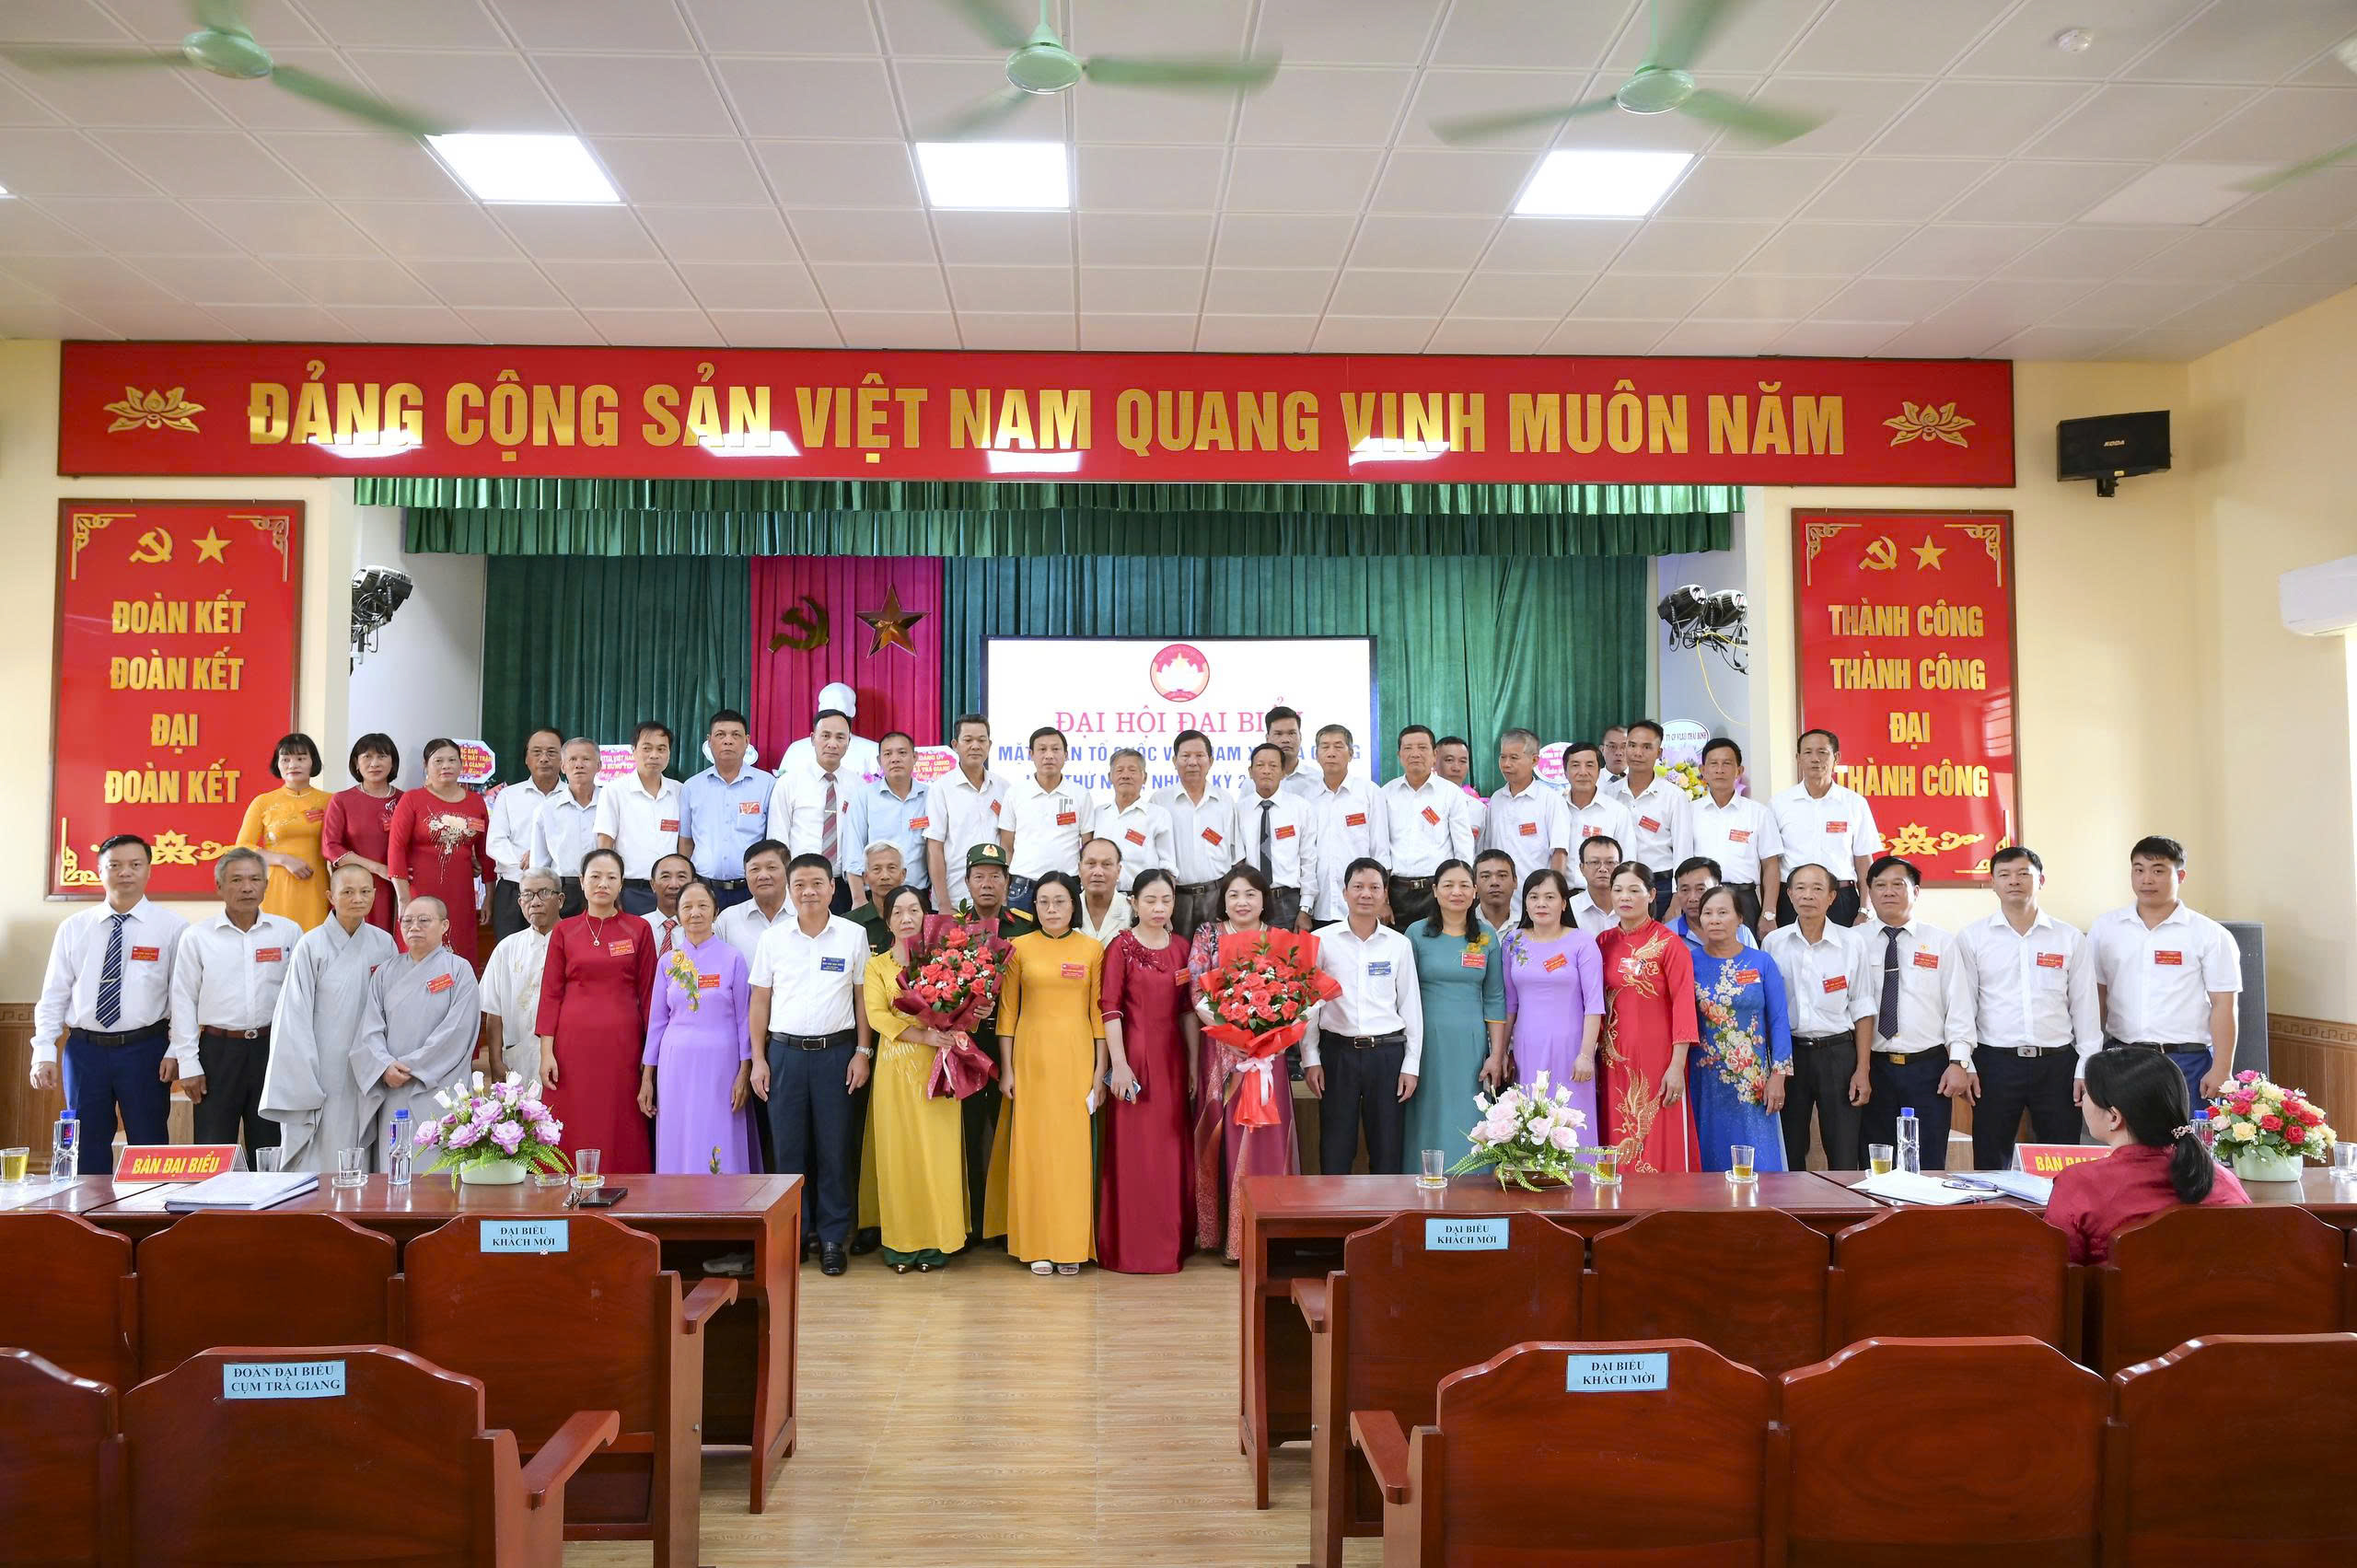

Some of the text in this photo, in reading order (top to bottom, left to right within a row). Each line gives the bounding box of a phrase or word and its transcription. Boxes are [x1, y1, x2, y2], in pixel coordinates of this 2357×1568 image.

[247, 360, 1845, 464] ĐẢNG CỘNG SẢN VIỆT NAM QUANG VINH MUÔN NĂM
[111, 589, 246, 633] ĐOÀN KẾT
[1828, 598, 1984, 637] THÀNH CÔNG
[110, 646, 244, 691] ĐOÀN KẾT
[1830, 651, 1987, 691] THÀNH CÔNG
[151, 714, 198, 754] ĐẠI
[1056, 712, 1105, 738] ĐẠI
[1116, 704, 1167, 738] HỘI
[1178, 712, 1226, 736] ĐẠI
[1889, 712, 1931, 750] ĐẠI
[103, 758, 240, 804] ĐOÀN KẾT
[1835, 758, 1990, 797] THÀNH CÔNG
[132, 1151, 221, 1177] BÀN ĐẠI BIỂU
[2035, 1152, 2063, 1171] BÀN
[493, 1236, 555, 1246] KHÁCH MỜI
[501, 1227, 518, 1237] ĐẠI
[1437, 1234, 1497, 1244] KHÁCH MỜI
[234, 1364, 333, 1379] ĐOÀN ĐẠI BIỂU
[1583, 1372, 1655, 1385] KHÁCH MỜI
[1591, 1362, 1613, 1373] ĐẠI
[231, 1382, 261, 1394] CỤM
[296, 1379, 340, 1390] GIANG
